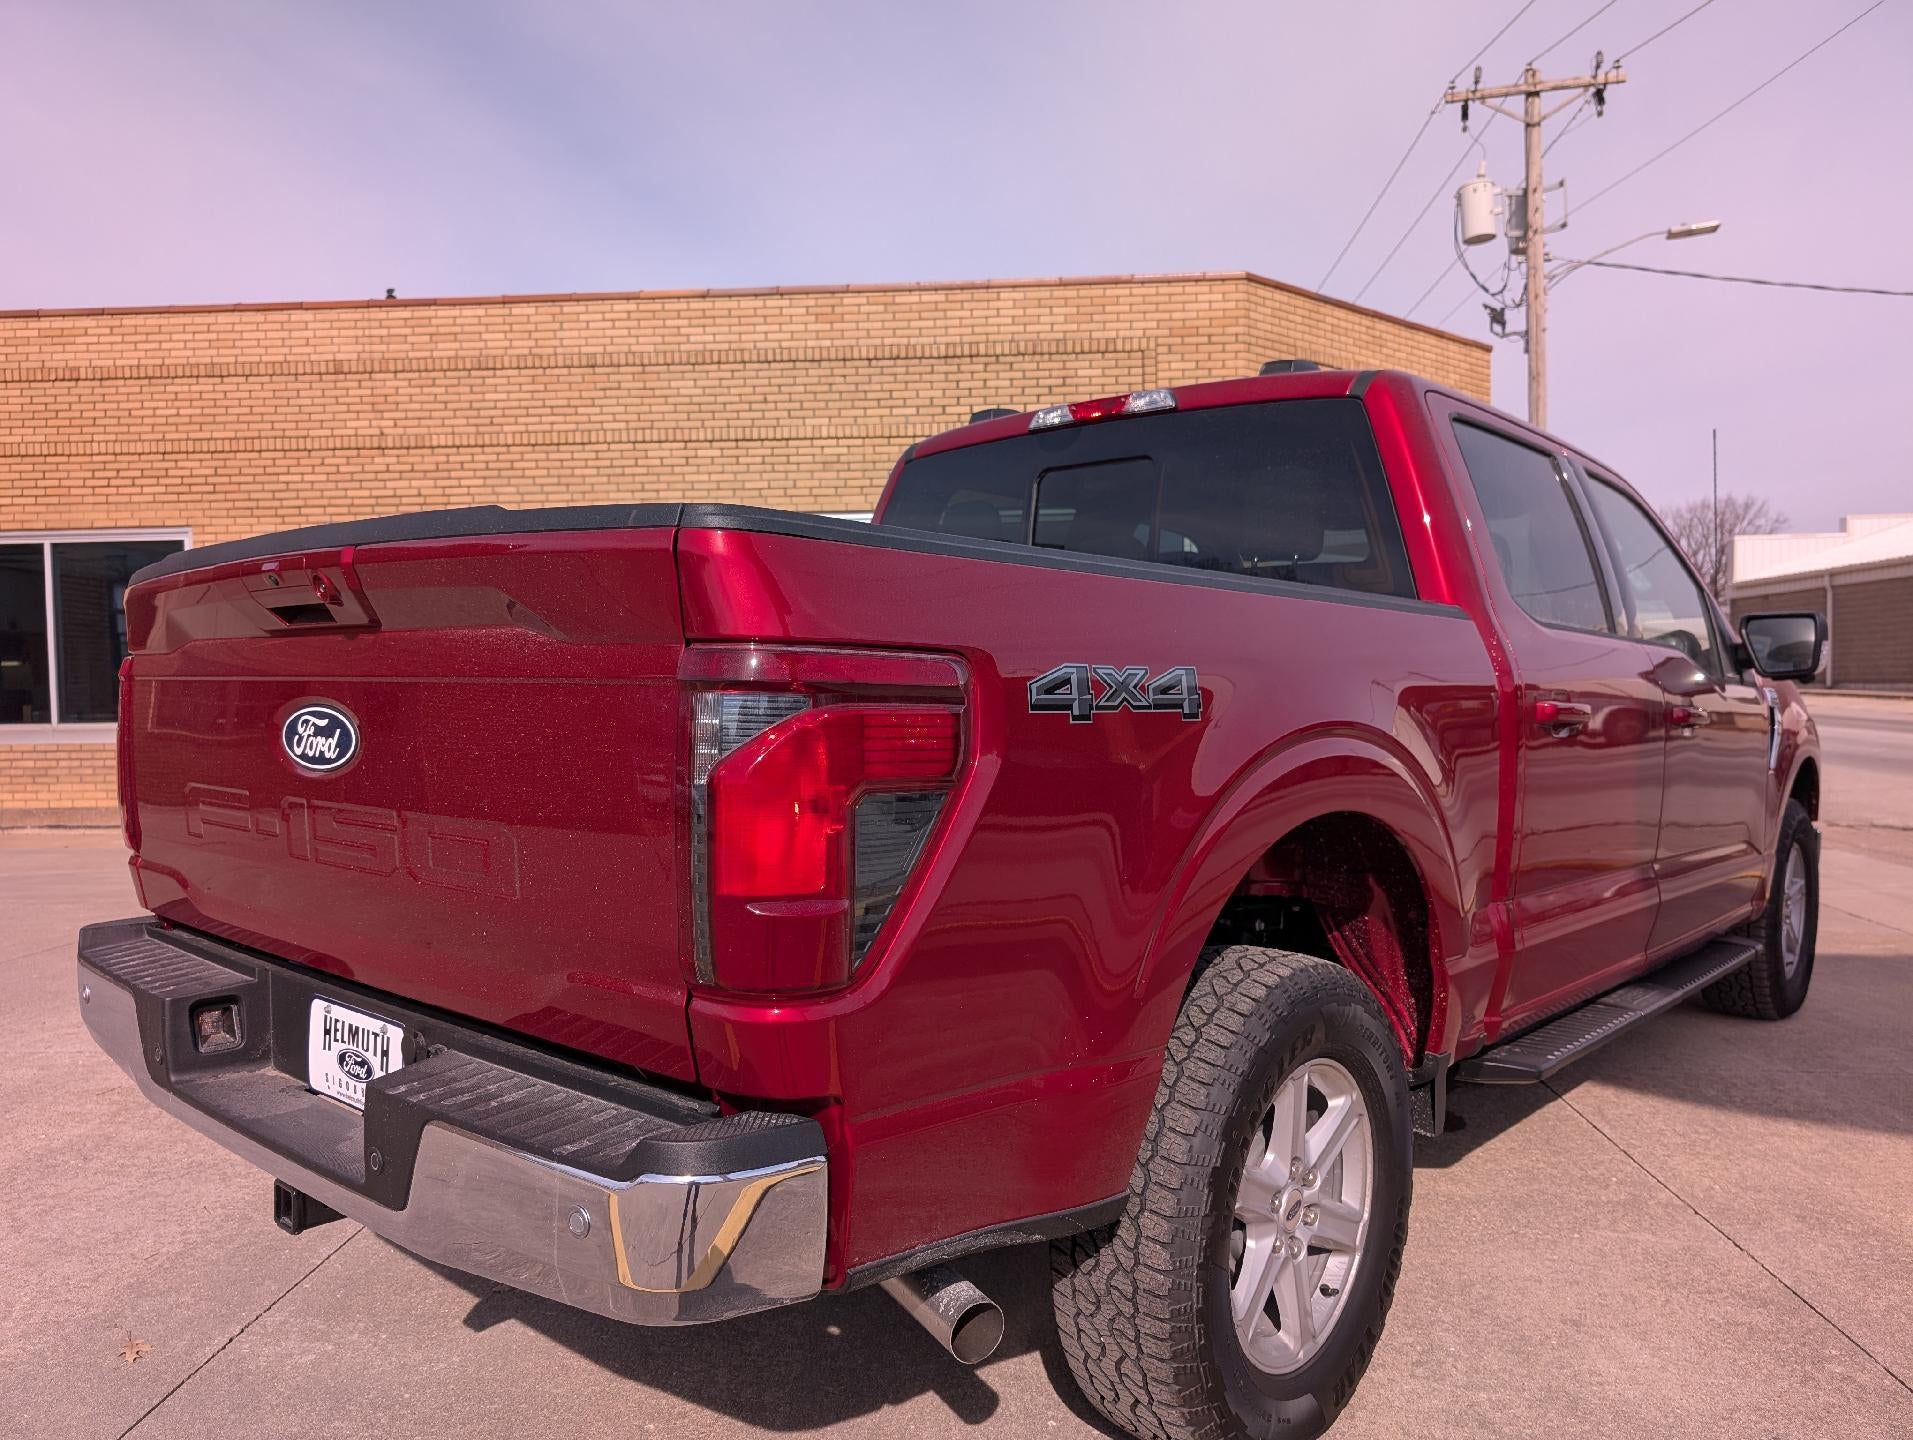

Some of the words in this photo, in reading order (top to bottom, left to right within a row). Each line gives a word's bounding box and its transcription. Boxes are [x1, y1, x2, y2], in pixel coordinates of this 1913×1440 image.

[293, 714, 341, 759] Ford
[184, 782, 519, 900] F-150
[323, 1014, 390, 1073] HELMUTH
[343, 1052, 368, 1080] Ford
